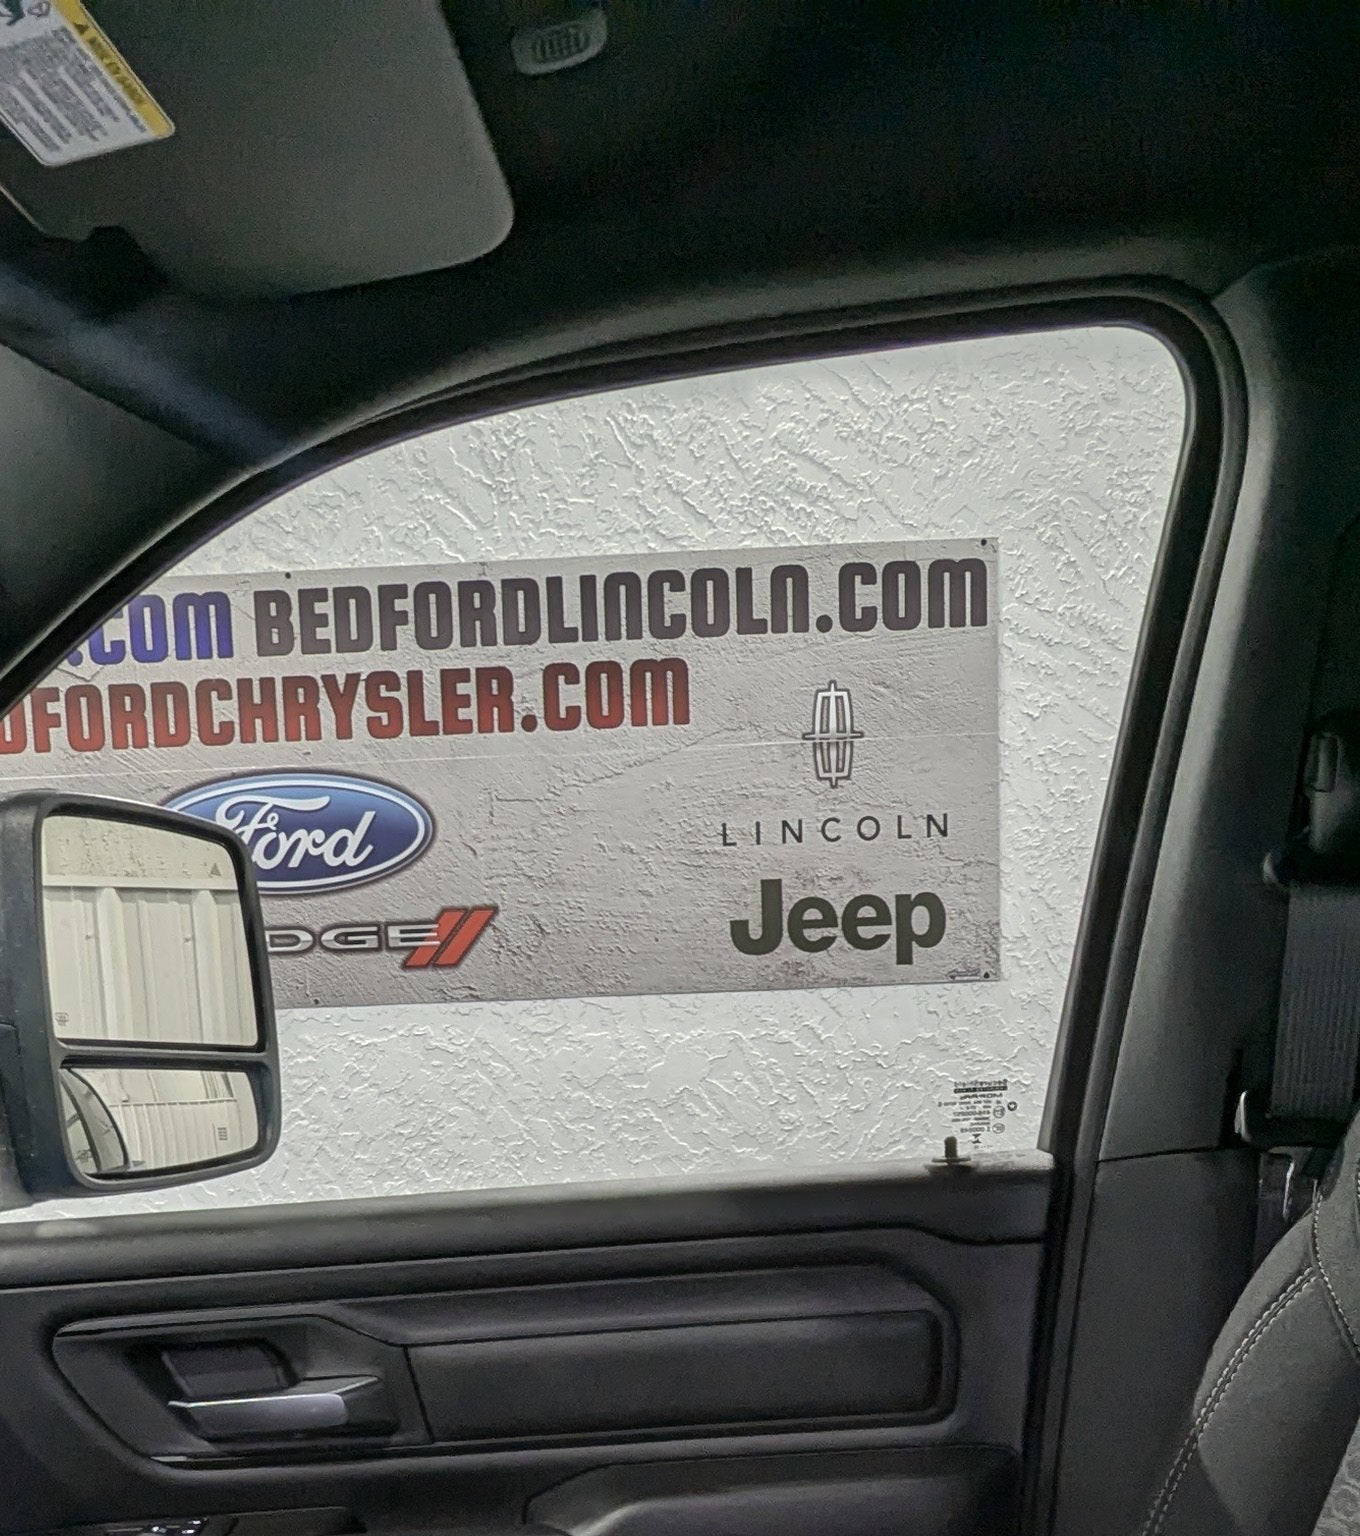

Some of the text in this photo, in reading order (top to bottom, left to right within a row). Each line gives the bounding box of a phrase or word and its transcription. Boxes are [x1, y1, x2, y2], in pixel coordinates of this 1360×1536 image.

[254, 557, 988, 657] BEDFORDLINCOLN.COM
[215, 795, 376, 870] Ford
[721, 812, 949, 847] LINCOLN
[730, 878, 947, 966] Jeep
